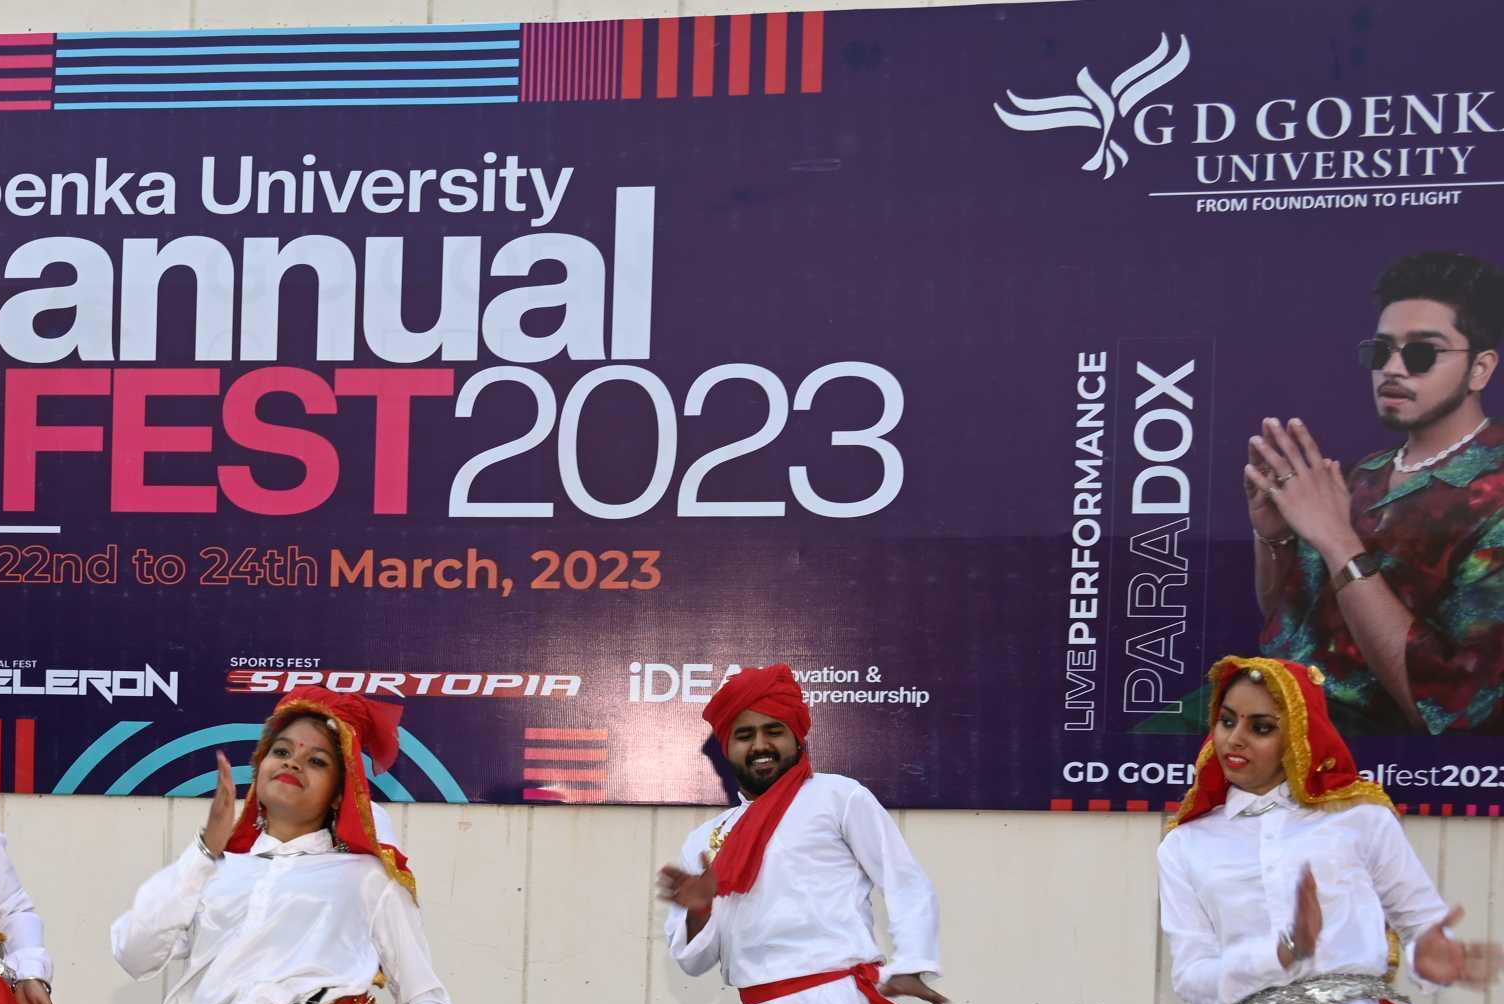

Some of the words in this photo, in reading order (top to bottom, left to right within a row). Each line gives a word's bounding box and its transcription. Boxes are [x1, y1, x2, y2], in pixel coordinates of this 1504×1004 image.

[1133, 103, 1176, 146] G
[1191, 102, 1237, 144] D
[1255, 91, 1504, 142] GOENK
[1195, 146, 1476, 184] UNIVERSITY
[201, 152, 575, 228] University
[1196, 199, 1248, 213] FROM
[1252, 194, 1368, 211] FOUNDATION
[1372, 192, 1397, 208] TO
[1401, 190, 1463, 207] FLIGHT
[1123, 358, 1196, 714] PARADOX
[132, 550, 187, 586] to
[199, 547, 319, 587] 24th
[329, 547, 515, 597] March,
[530, 549, 662, 591] 2023
[12, 659, 38, 669] FEST
[229, 656, 286, 669] SPORTS
[287, 657, 321, 669] FEST
[865, 665, 883, 684] &
[247, 670, 583, 698] SPORTOPIA
[1062, 761, 1110, 784] GD
[1117, 761, 1198, 786] GOE
